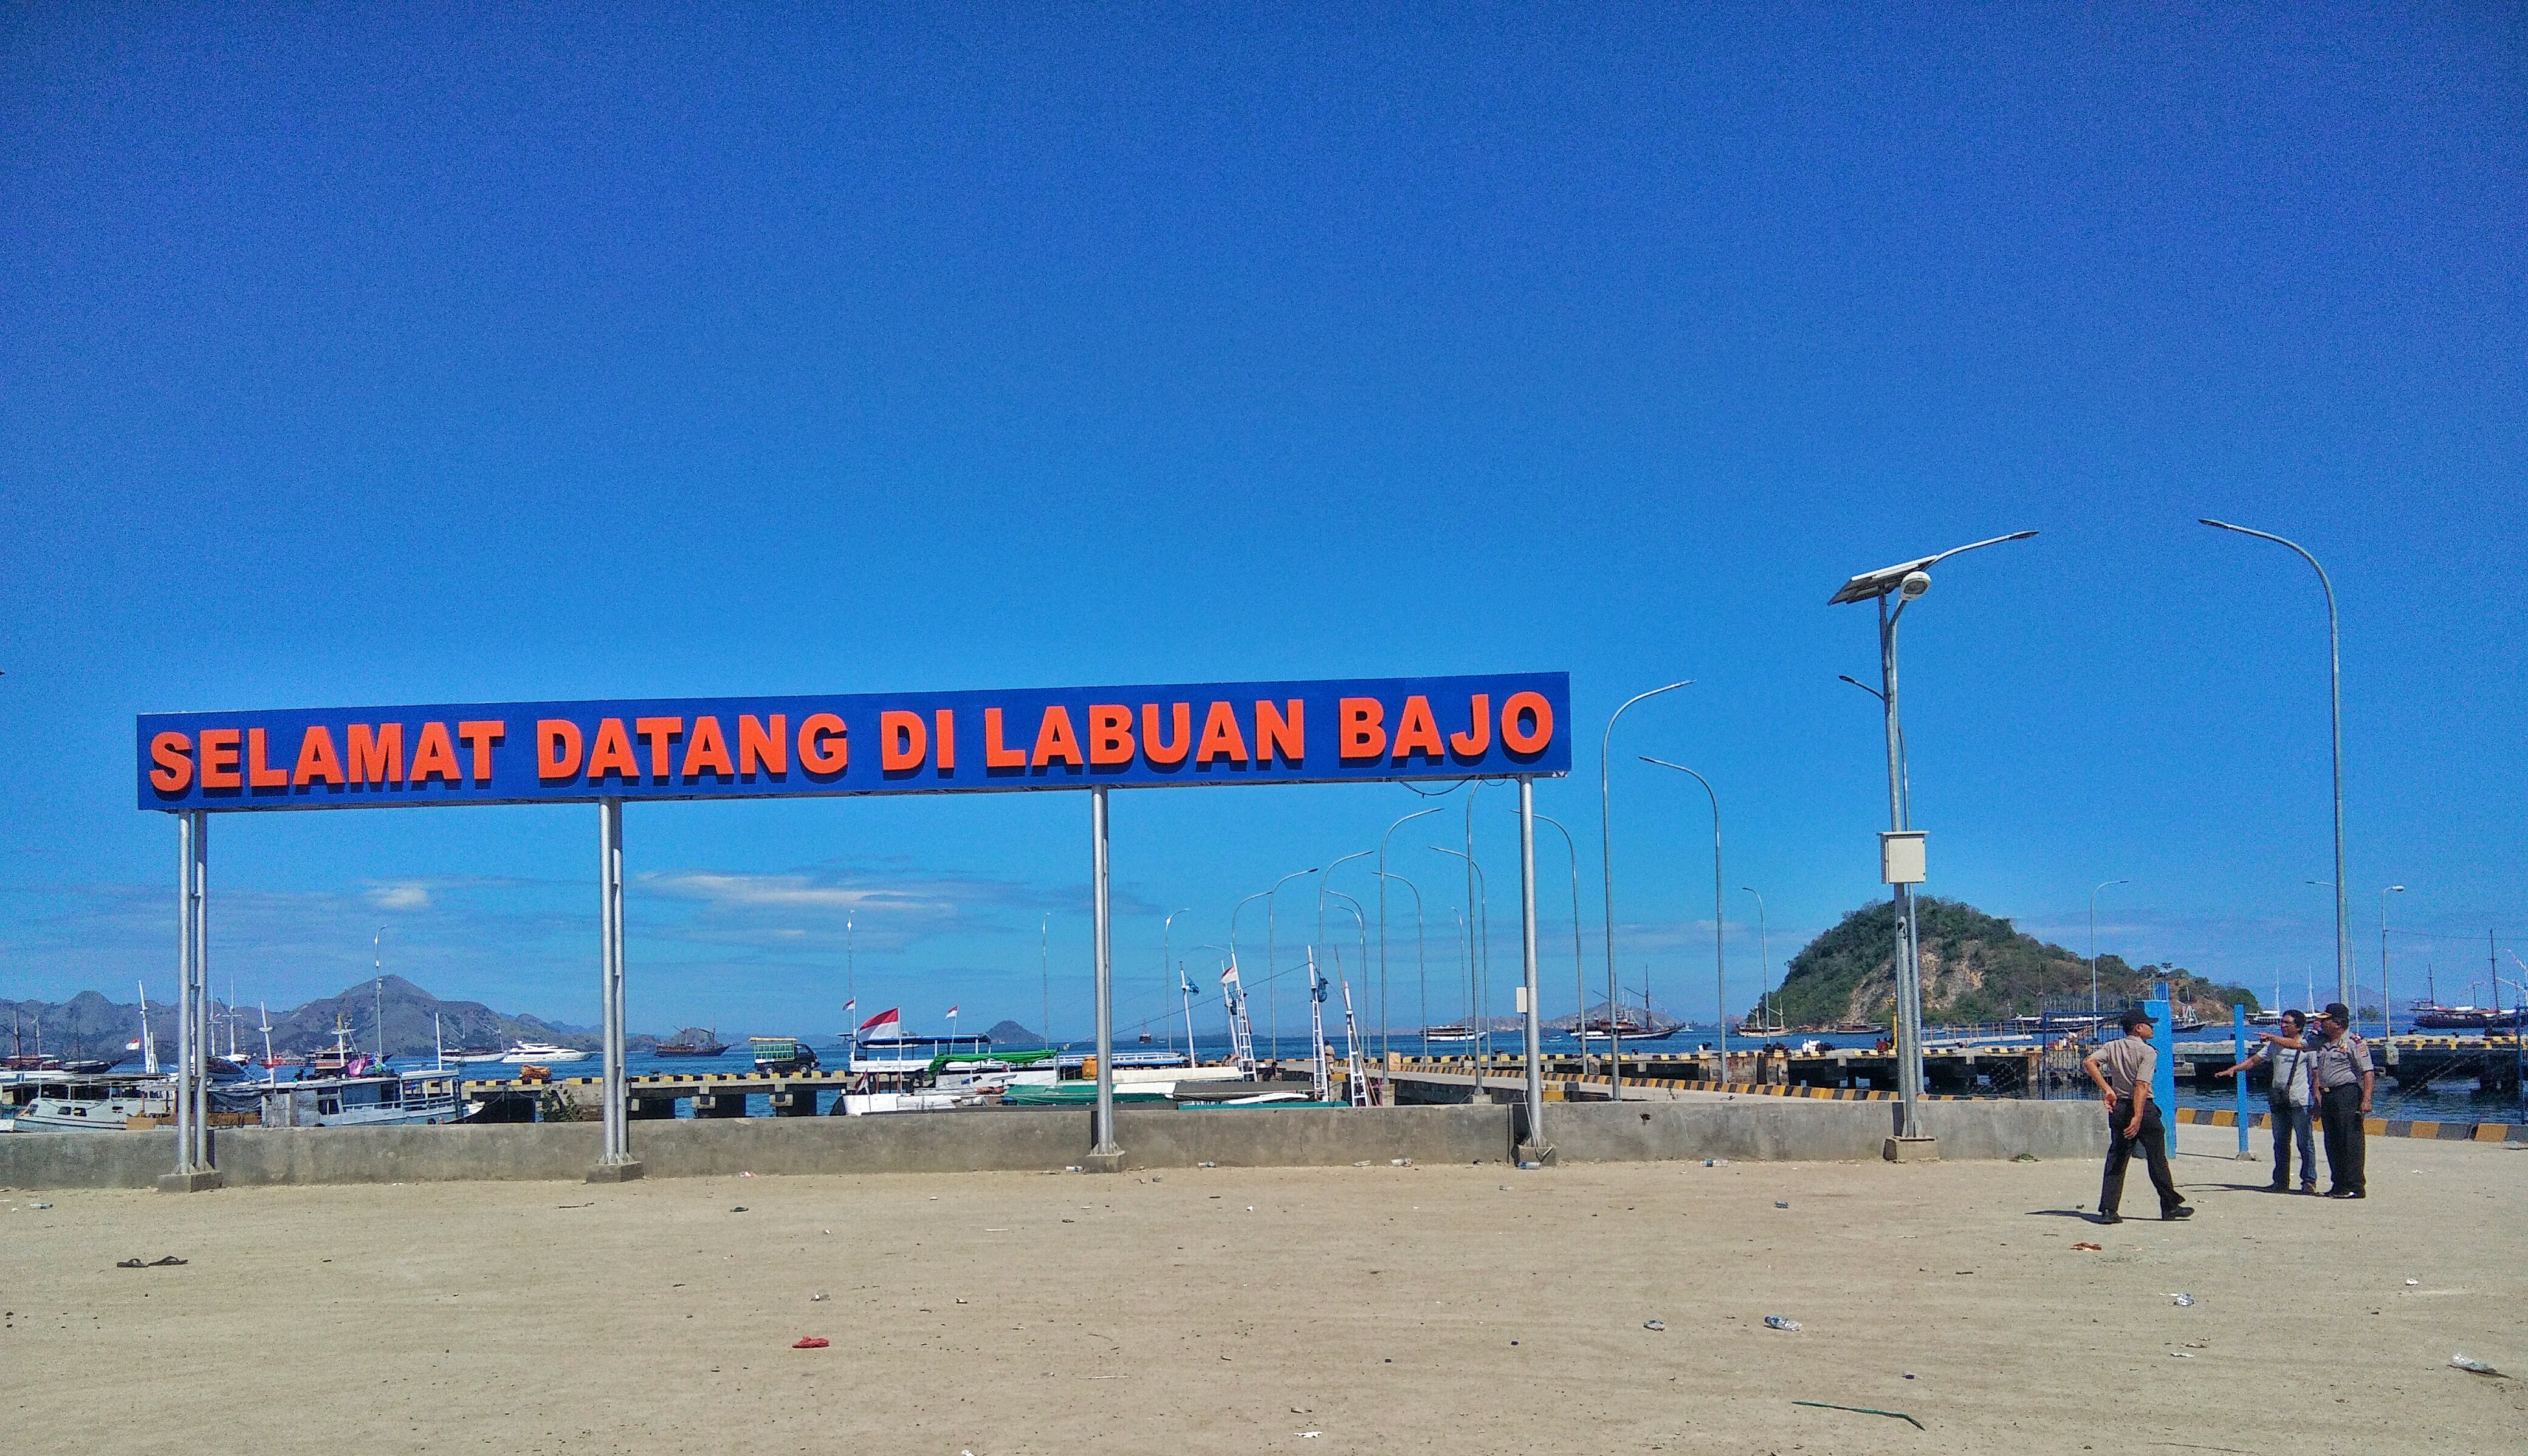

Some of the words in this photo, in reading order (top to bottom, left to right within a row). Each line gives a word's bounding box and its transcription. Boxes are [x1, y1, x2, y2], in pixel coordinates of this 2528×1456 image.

[149, 721, 504, 792] SELAMAT
[537, 713, 848, 779] DATANG
[881, 710, 954, 771] DI
[985, 699, 1304, 767] LABUAN
[1340, 692, 1553, 758] BAJO
